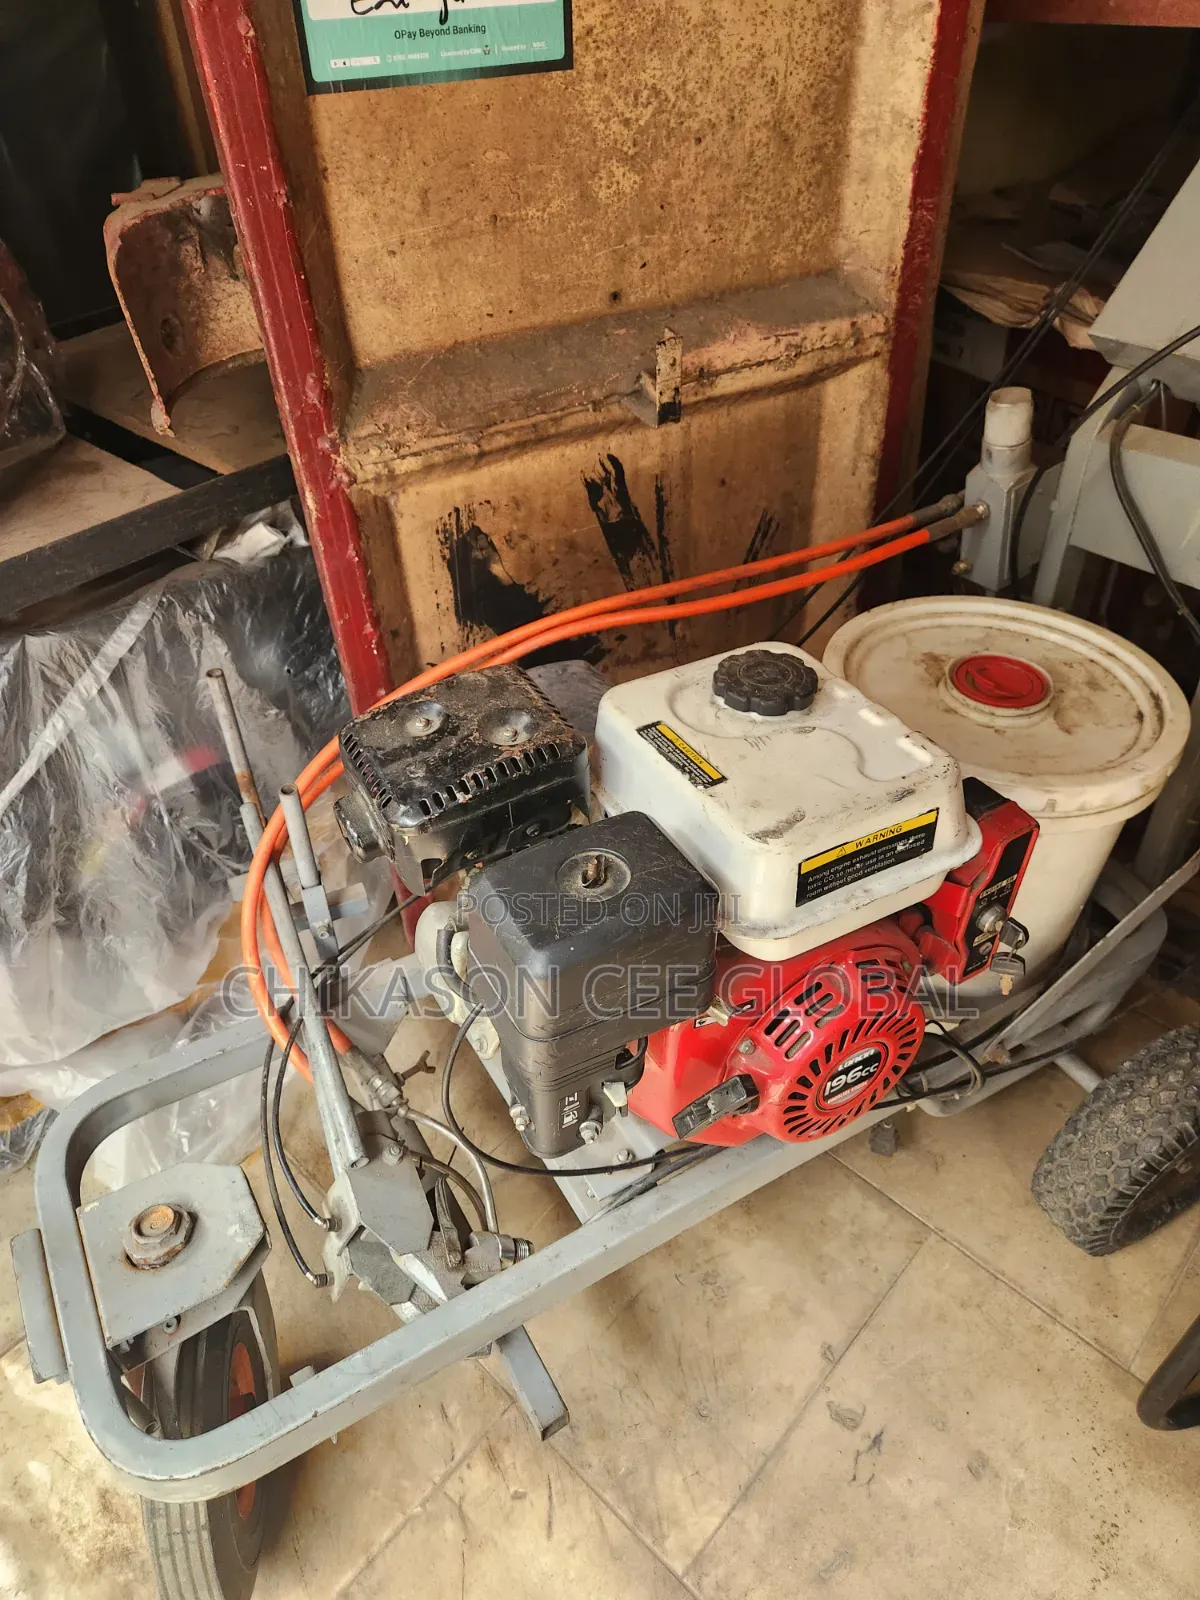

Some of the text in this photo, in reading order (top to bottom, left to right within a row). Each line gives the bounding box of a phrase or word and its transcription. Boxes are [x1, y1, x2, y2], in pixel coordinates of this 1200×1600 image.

[394, 24, 486, 41] OPay Beyond Banking
[678, 742, 704, 765] CAUTION
[855, 825, 903, 849] WARNING
[807, 869, 830, 883] Among
[830, 860, 851, 875] engine
[852, 849, 877, 863] exhaust
[807, 881, 823, 891] toxic
[865, 858, 877, 867] use
[885, 850, 894, 858] an
[806, 888, 823, 899] room
[823, 877, 847, 892] without
[847, 870, 863, 882] good
[824, 1062, 880, 1097] 196cc
